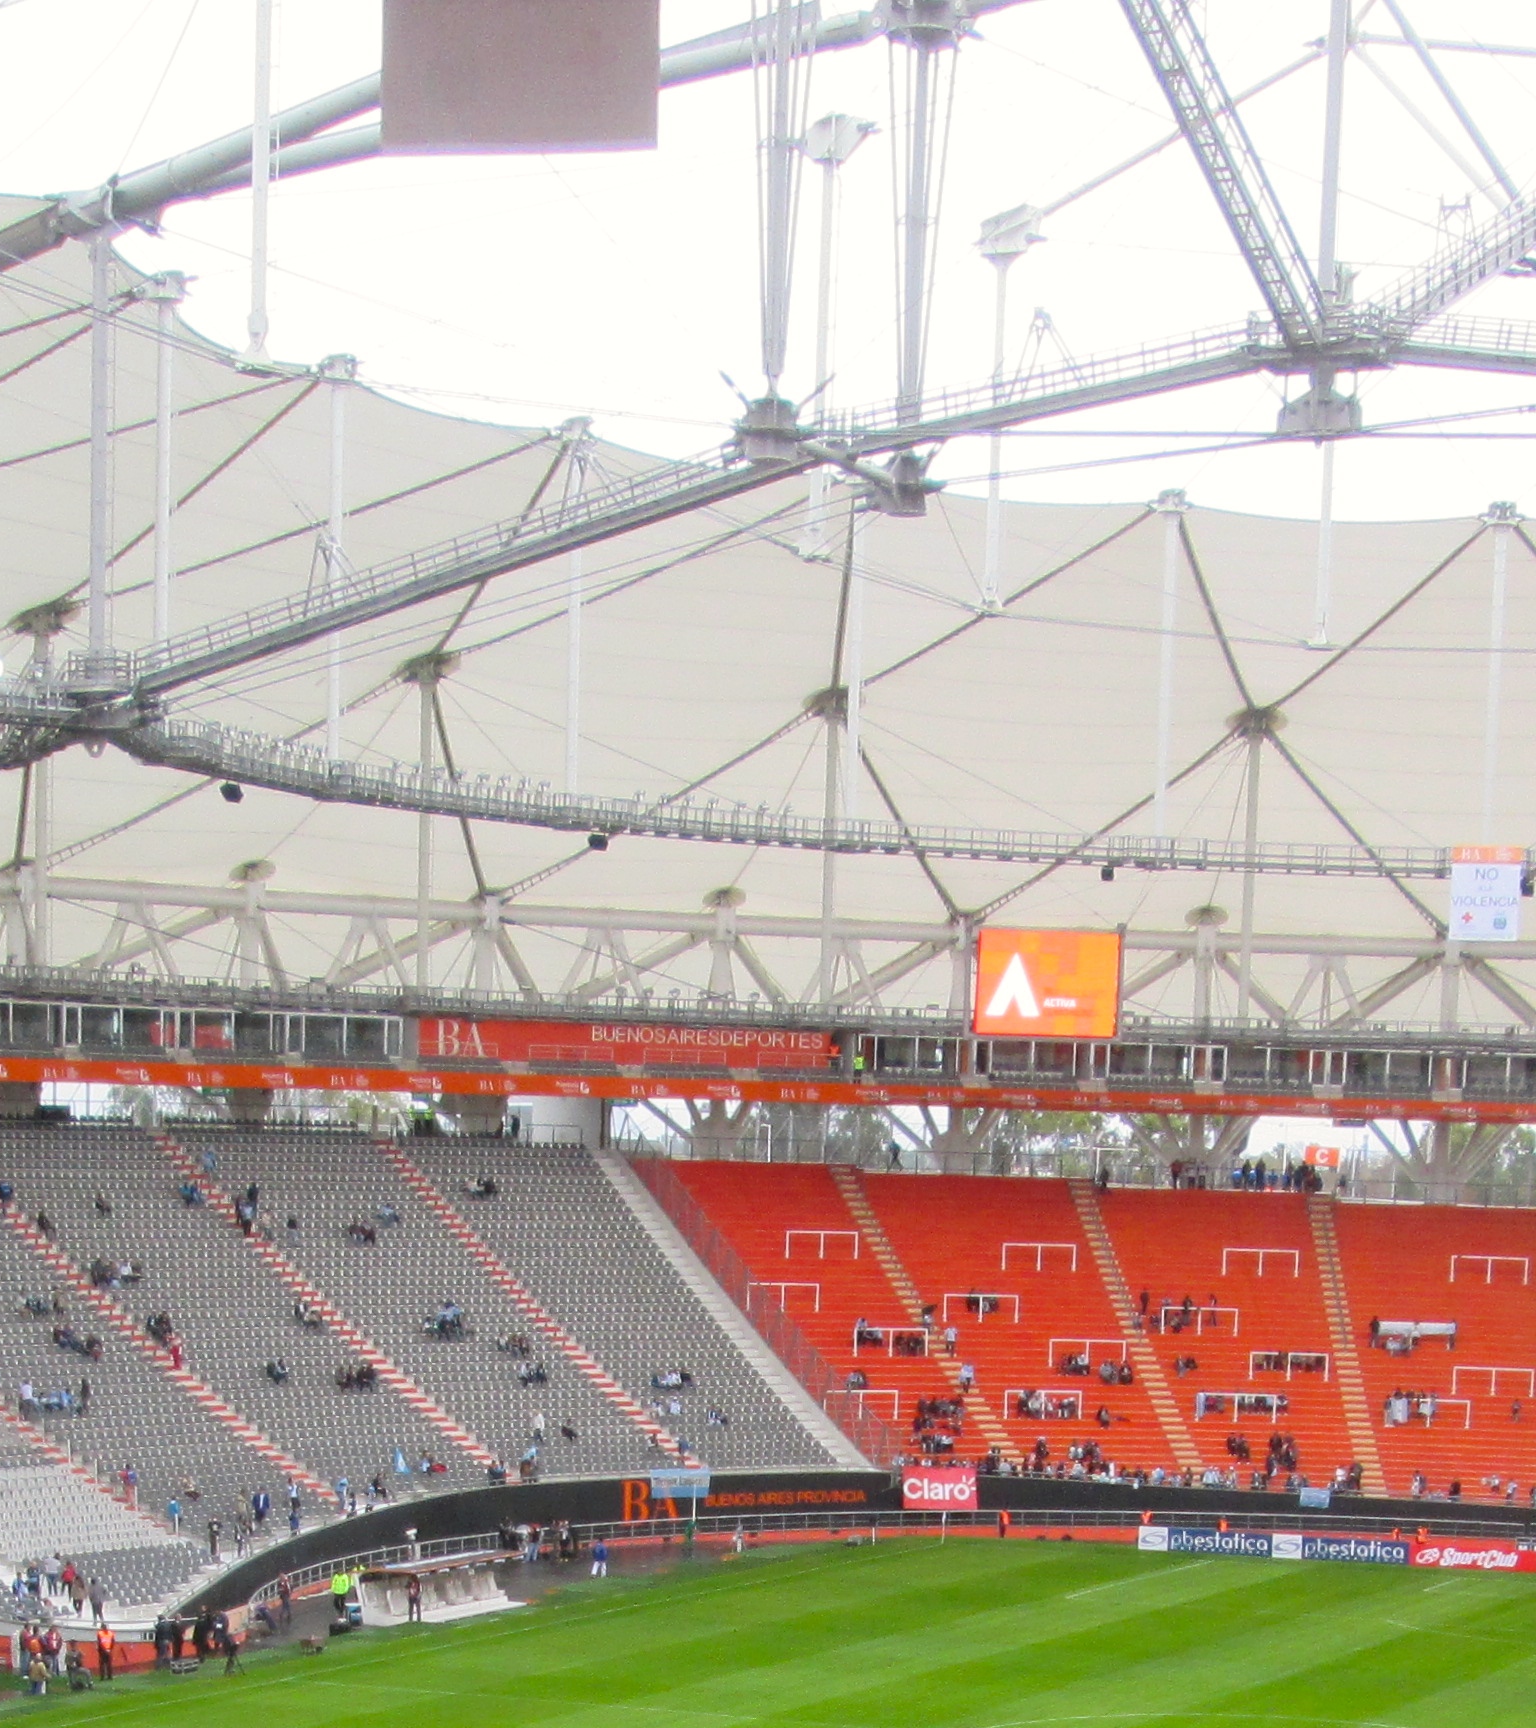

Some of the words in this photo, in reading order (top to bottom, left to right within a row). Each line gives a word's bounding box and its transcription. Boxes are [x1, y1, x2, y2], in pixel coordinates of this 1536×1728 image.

[1475, 868, 1499, 880] NO
[1452, 895, 1518, 907] VIOLENCIA
[1043, 997, 1076, 1009] ACTIVA
[437, 1018, 487, 1058] BA
[1315, 1148, 1330, 1164] C
[902, 1475, 972, 1501] Claro
[704, 1491, 755, 1507] BUENOS
[760, 1490, 794, 1506] AIRES
[797, 1488, 867, 1504] PROVINCIA
